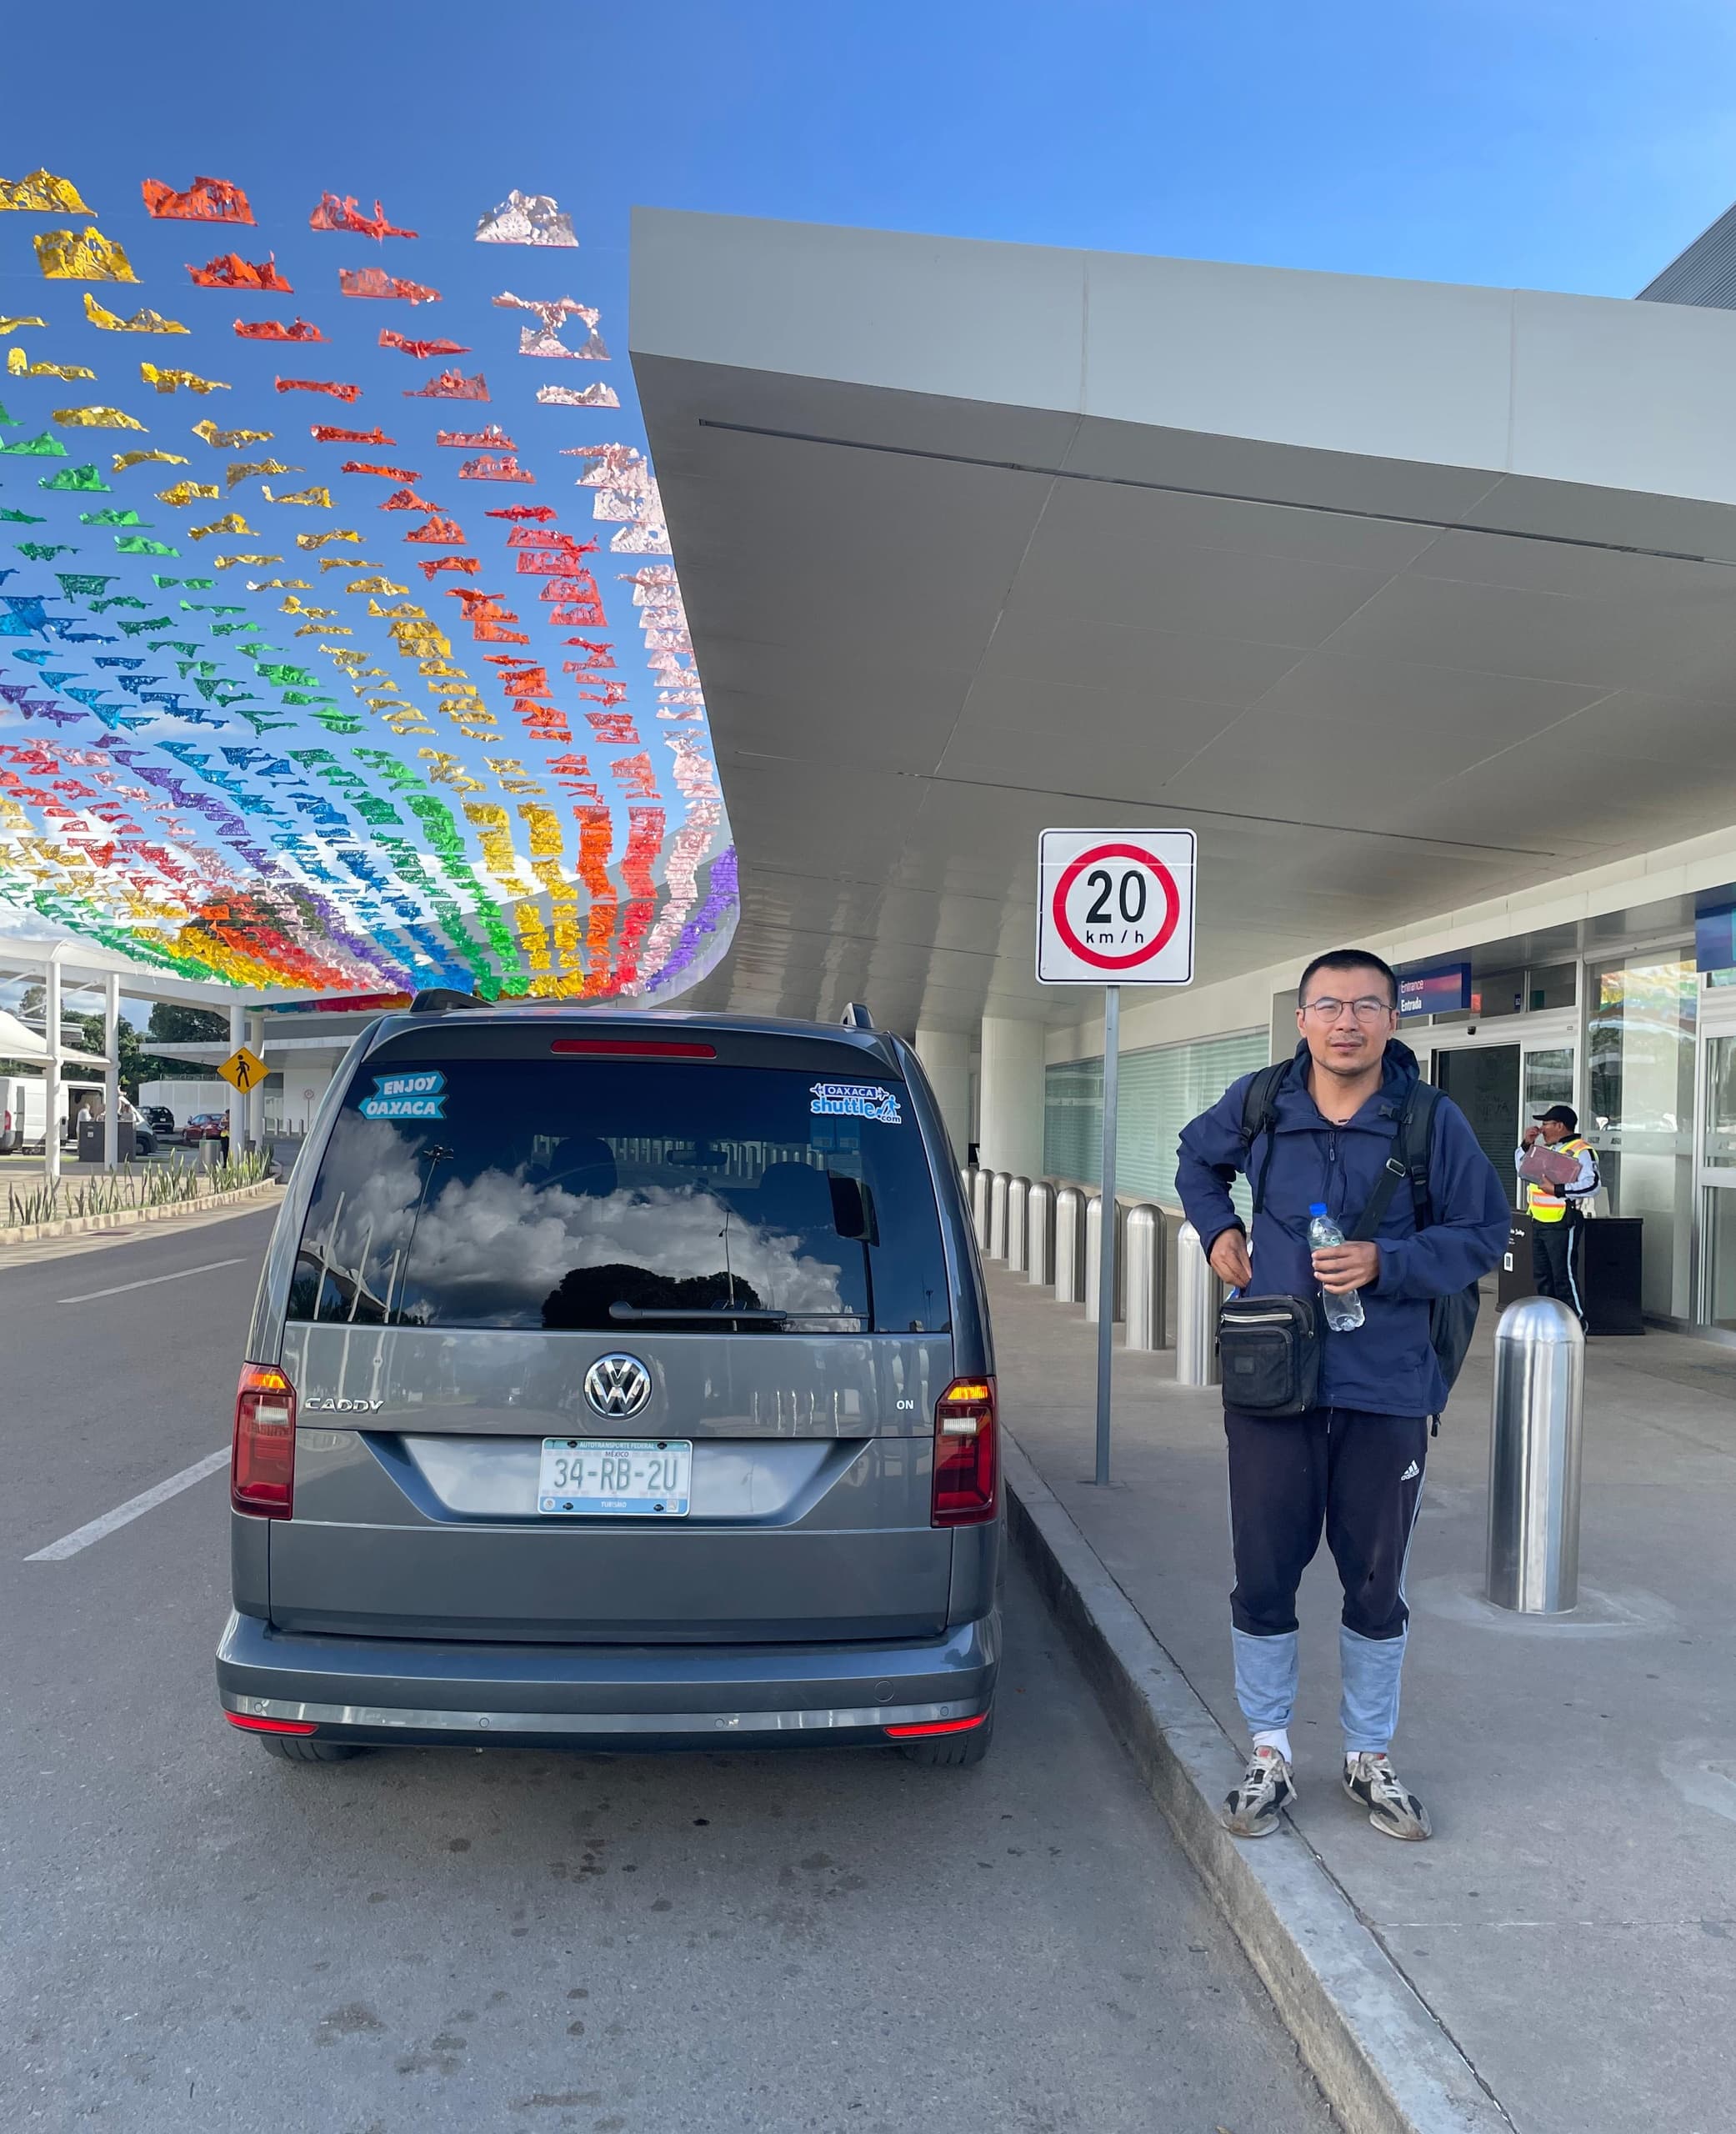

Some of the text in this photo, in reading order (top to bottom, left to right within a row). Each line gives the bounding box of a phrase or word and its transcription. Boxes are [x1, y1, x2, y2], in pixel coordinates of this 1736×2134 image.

[1086, 869, 1146, 924] 20
[1086, 930, 1144, 944] km/h
[1401, 979, 1424, 994] Entrance
[1401, 996, 1422, 1012] Entrada
[383, 1075, 438, 1095] ENJOY
[828, 1086, 874, 1097] OAXACA
[366, 1101, 436, 1115] OAXACA
[304, 1397, 383, 1414] CADDY
[896, 1400, 914, 1410] ON
[605, 1450, 629, 1458] MÉXICO
[553, 1457, 678, 1491] 34-RB-2U
